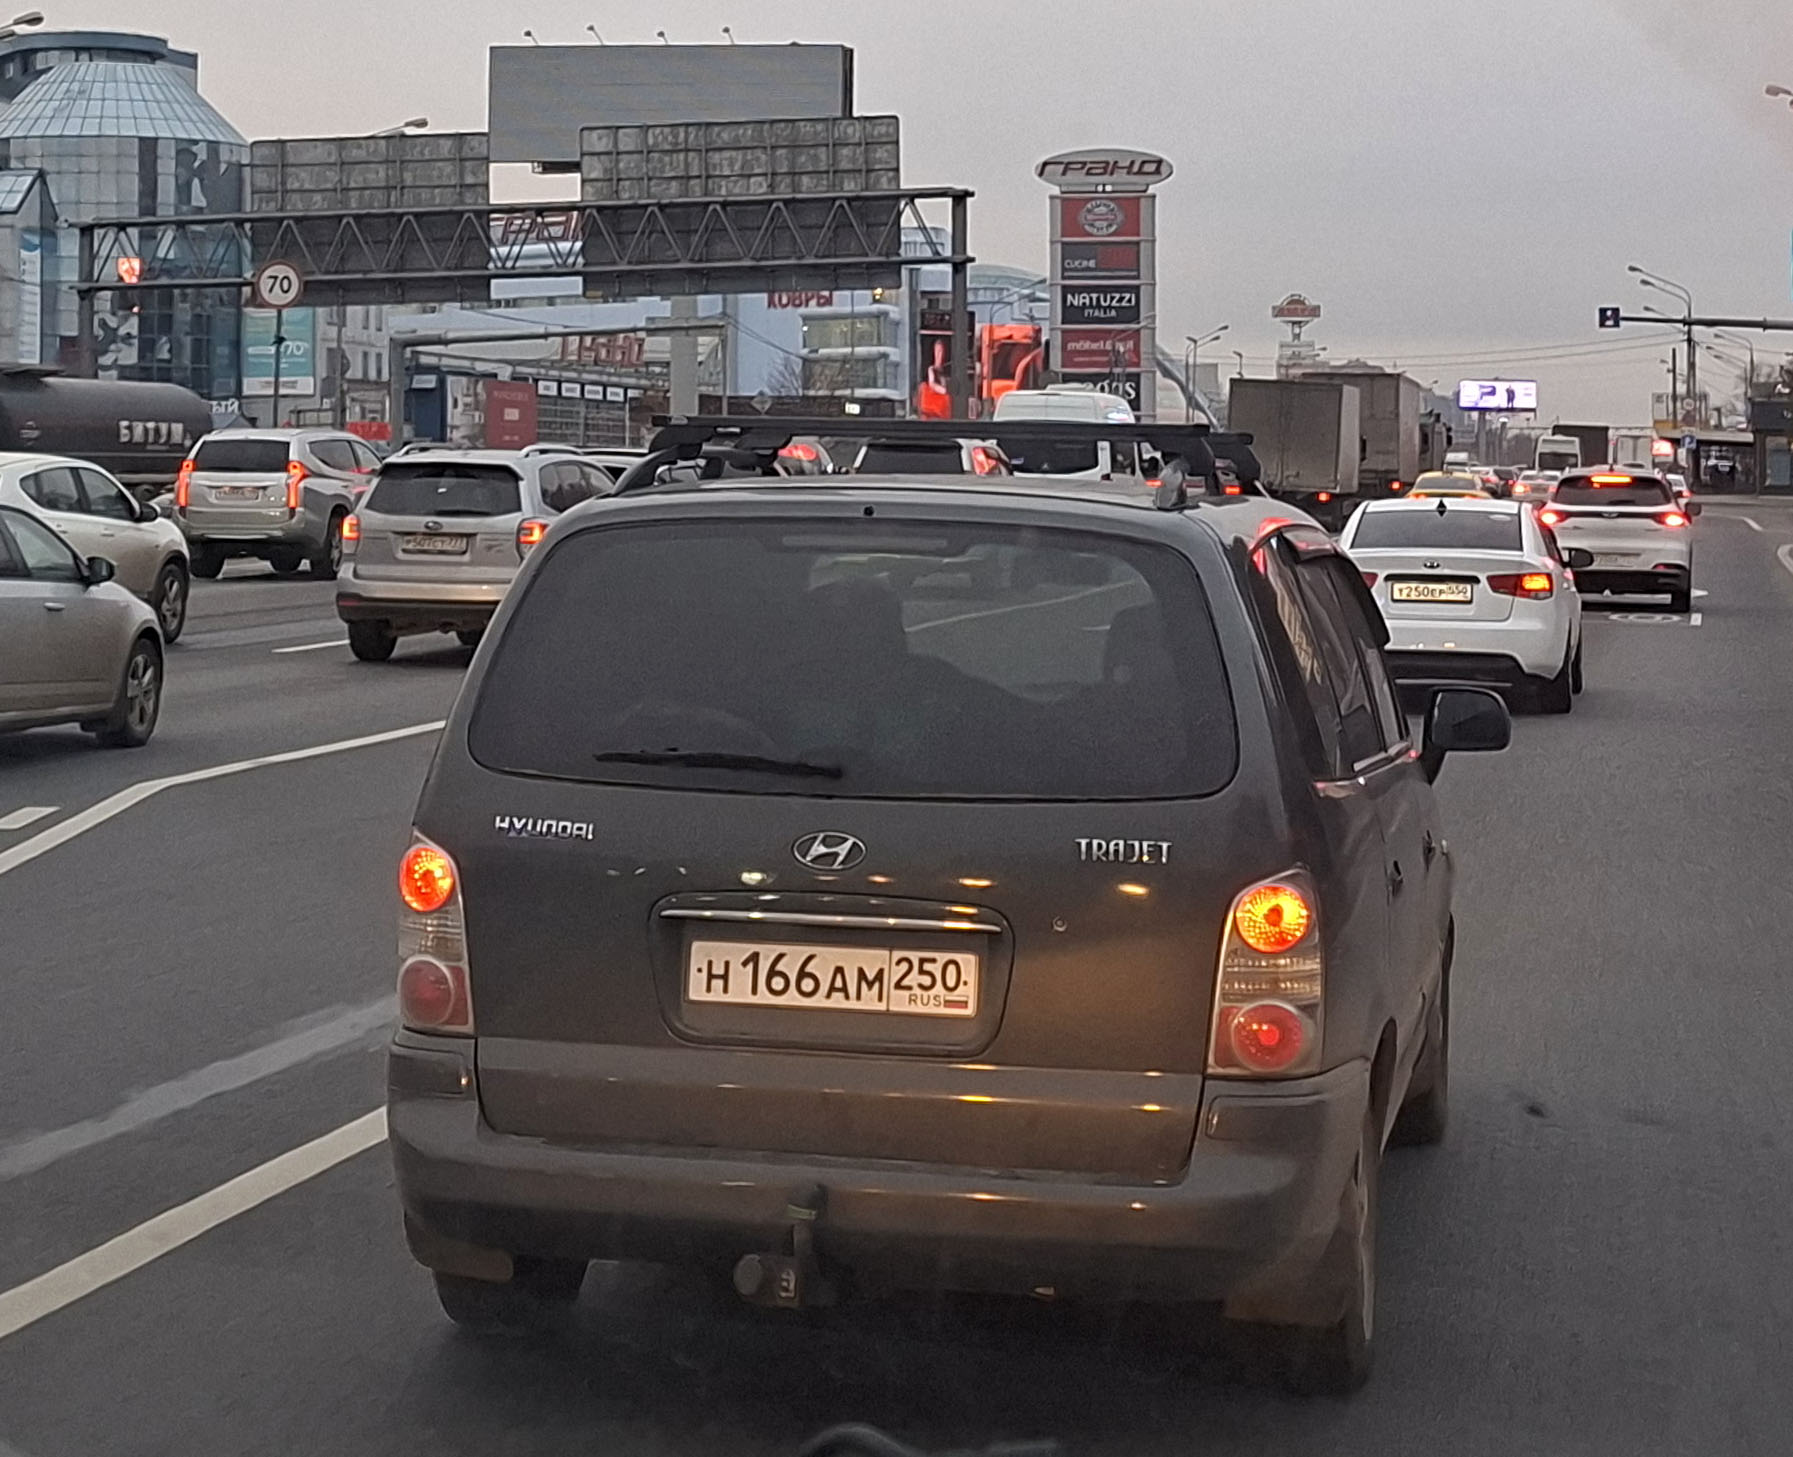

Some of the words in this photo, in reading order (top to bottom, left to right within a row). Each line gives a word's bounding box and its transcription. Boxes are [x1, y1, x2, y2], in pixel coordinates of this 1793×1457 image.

[267, 275, 292, 294] 70
[767, 290, 834, 309] КОВРЫ
[1066, 293, 1136, 307] NATUZZI
[1084, 308, 1118, 318] ITALIA
[208, 398, 240, 415] ЫЙ
[118, 420, 184, 444] БИТУМ
[495, 815, 594, 841] HYUNDAI
[1074, 838, 1173, 864] TRAJET
[893, 956, 962, 993] 250
[908, 993, 942, 1007] RUS
